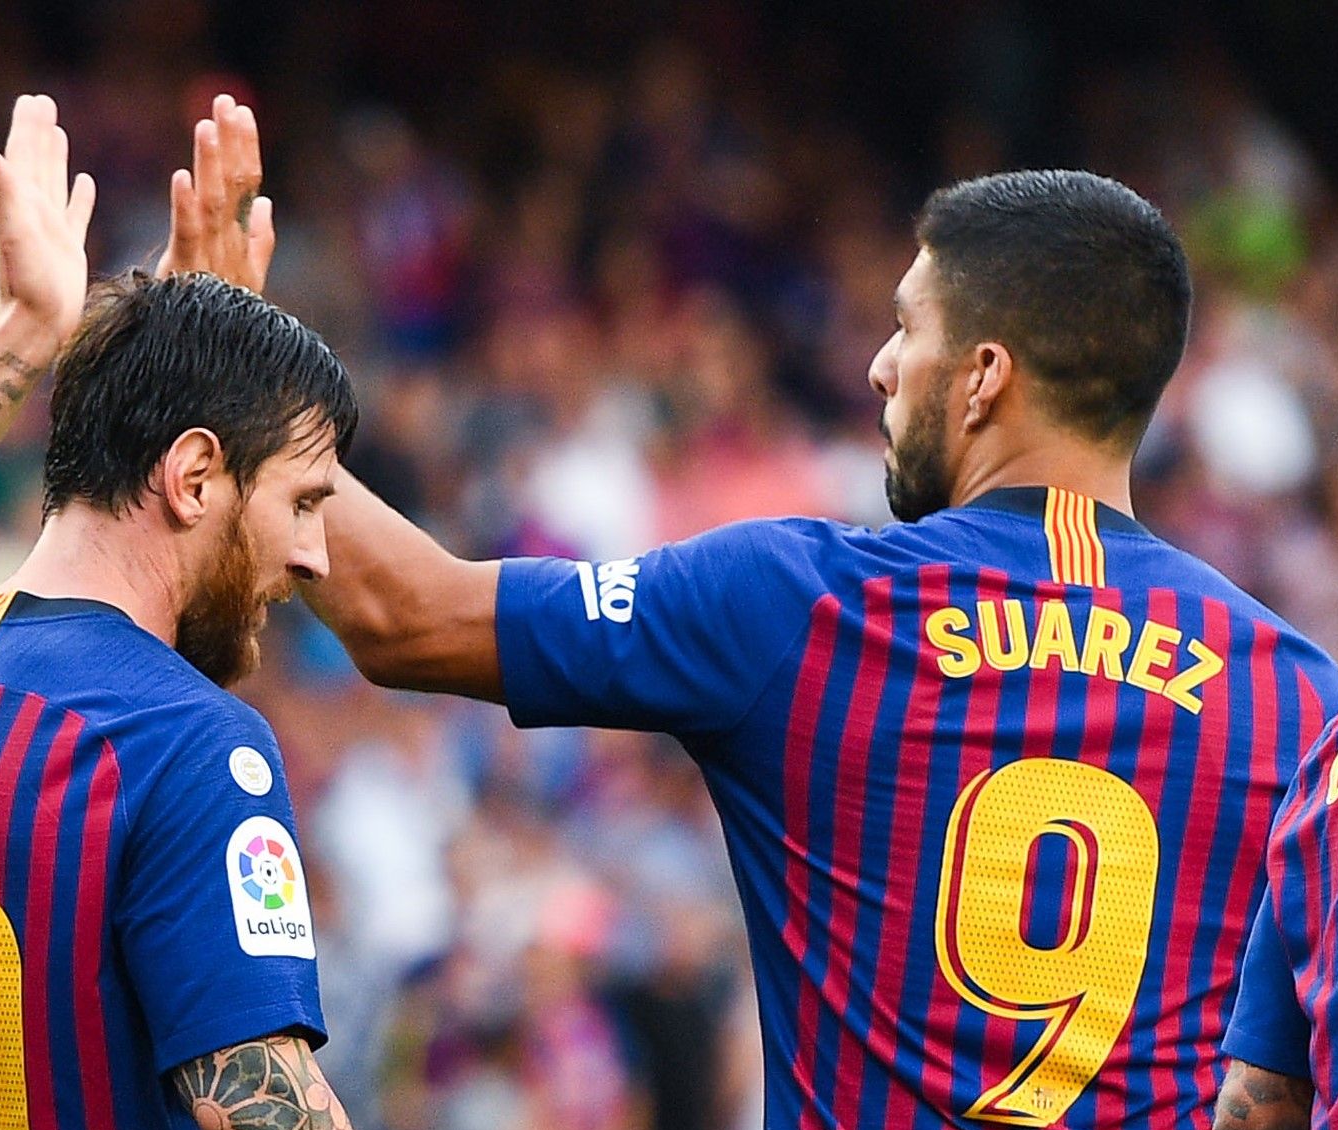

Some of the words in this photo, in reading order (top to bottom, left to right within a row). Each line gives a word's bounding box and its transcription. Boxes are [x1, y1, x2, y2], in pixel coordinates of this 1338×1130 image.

[925, 599, 1224, 714] SUAREZ
[246, 916, 307, 940] LaLiga
[936, 757, 1159, 1127] 9
